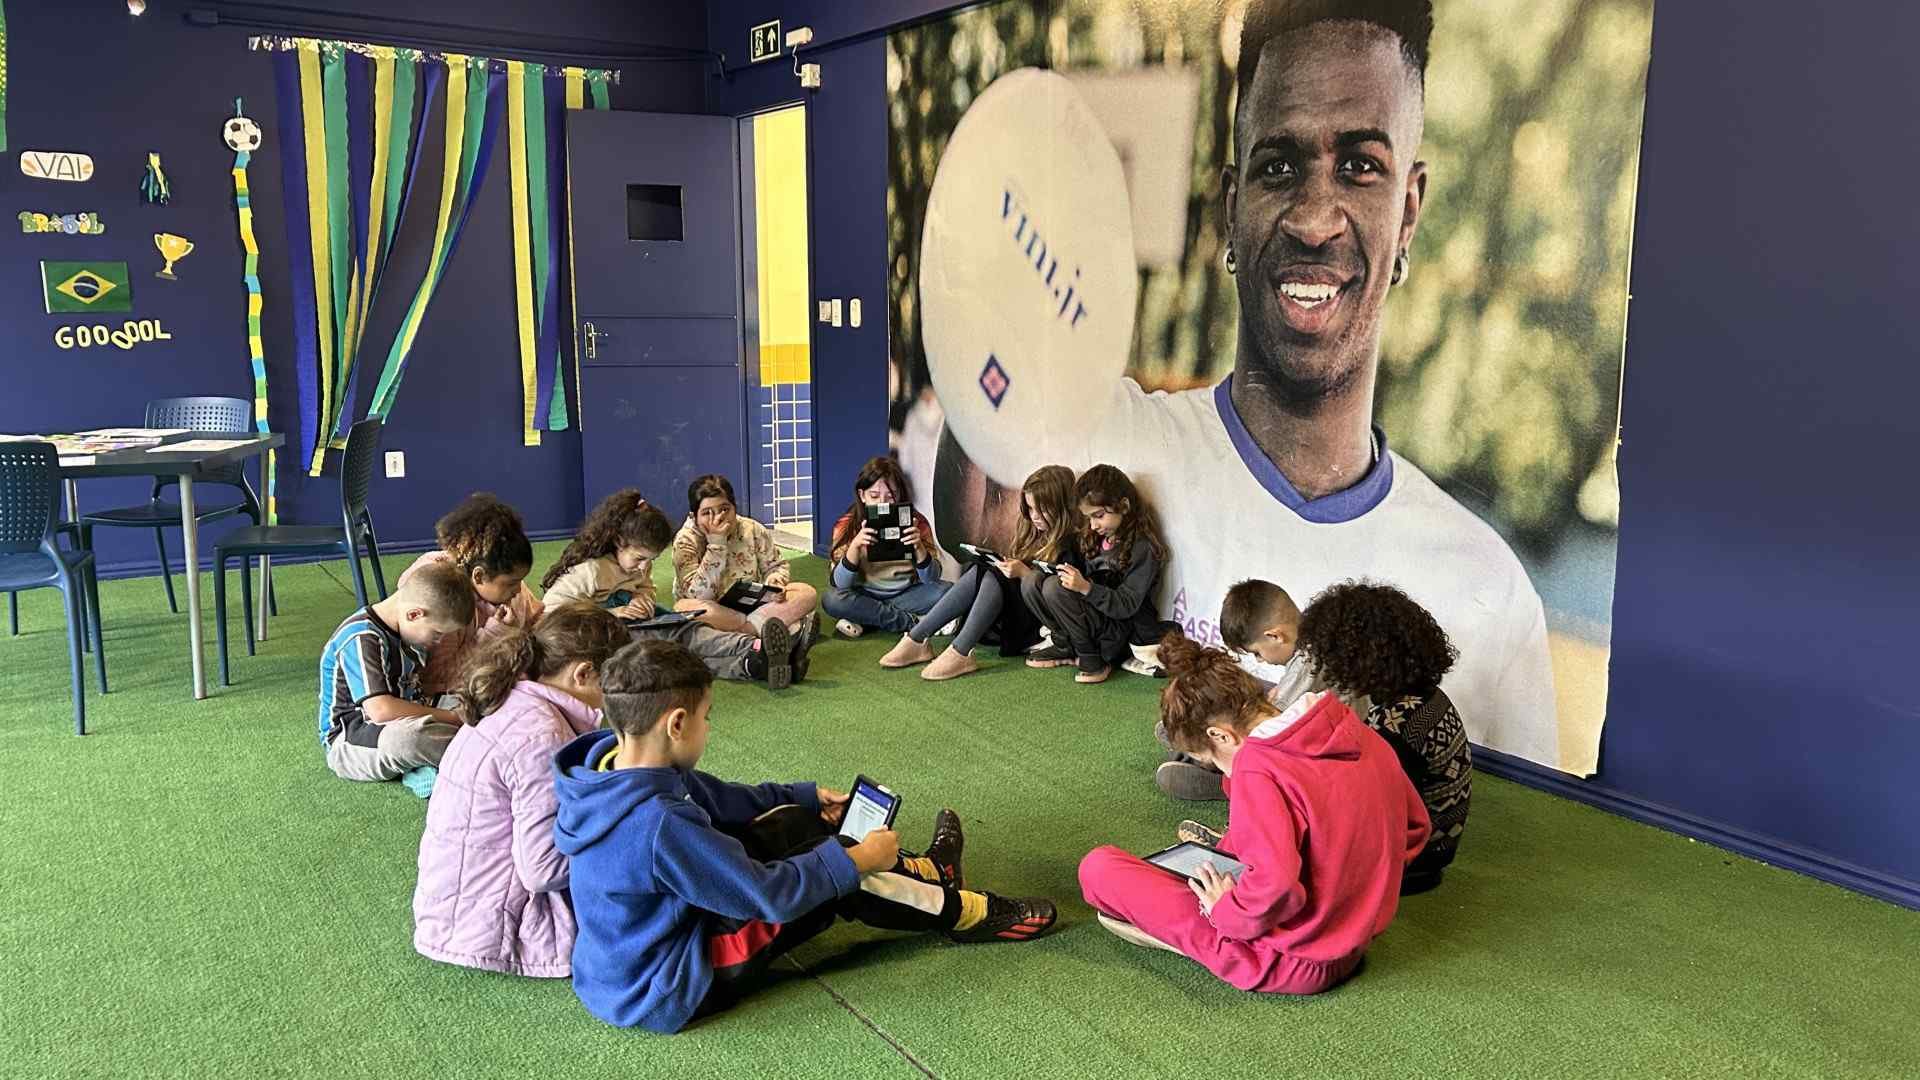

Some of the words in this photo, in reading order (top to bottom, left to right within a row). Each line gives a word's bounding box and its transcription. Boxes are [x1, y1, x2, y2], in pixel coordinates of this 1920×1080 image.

[33, 153, 82, 179] VAI
[55, 320, 171, 349] GOOOOOL
[1173, 587, 1187, 610] A
